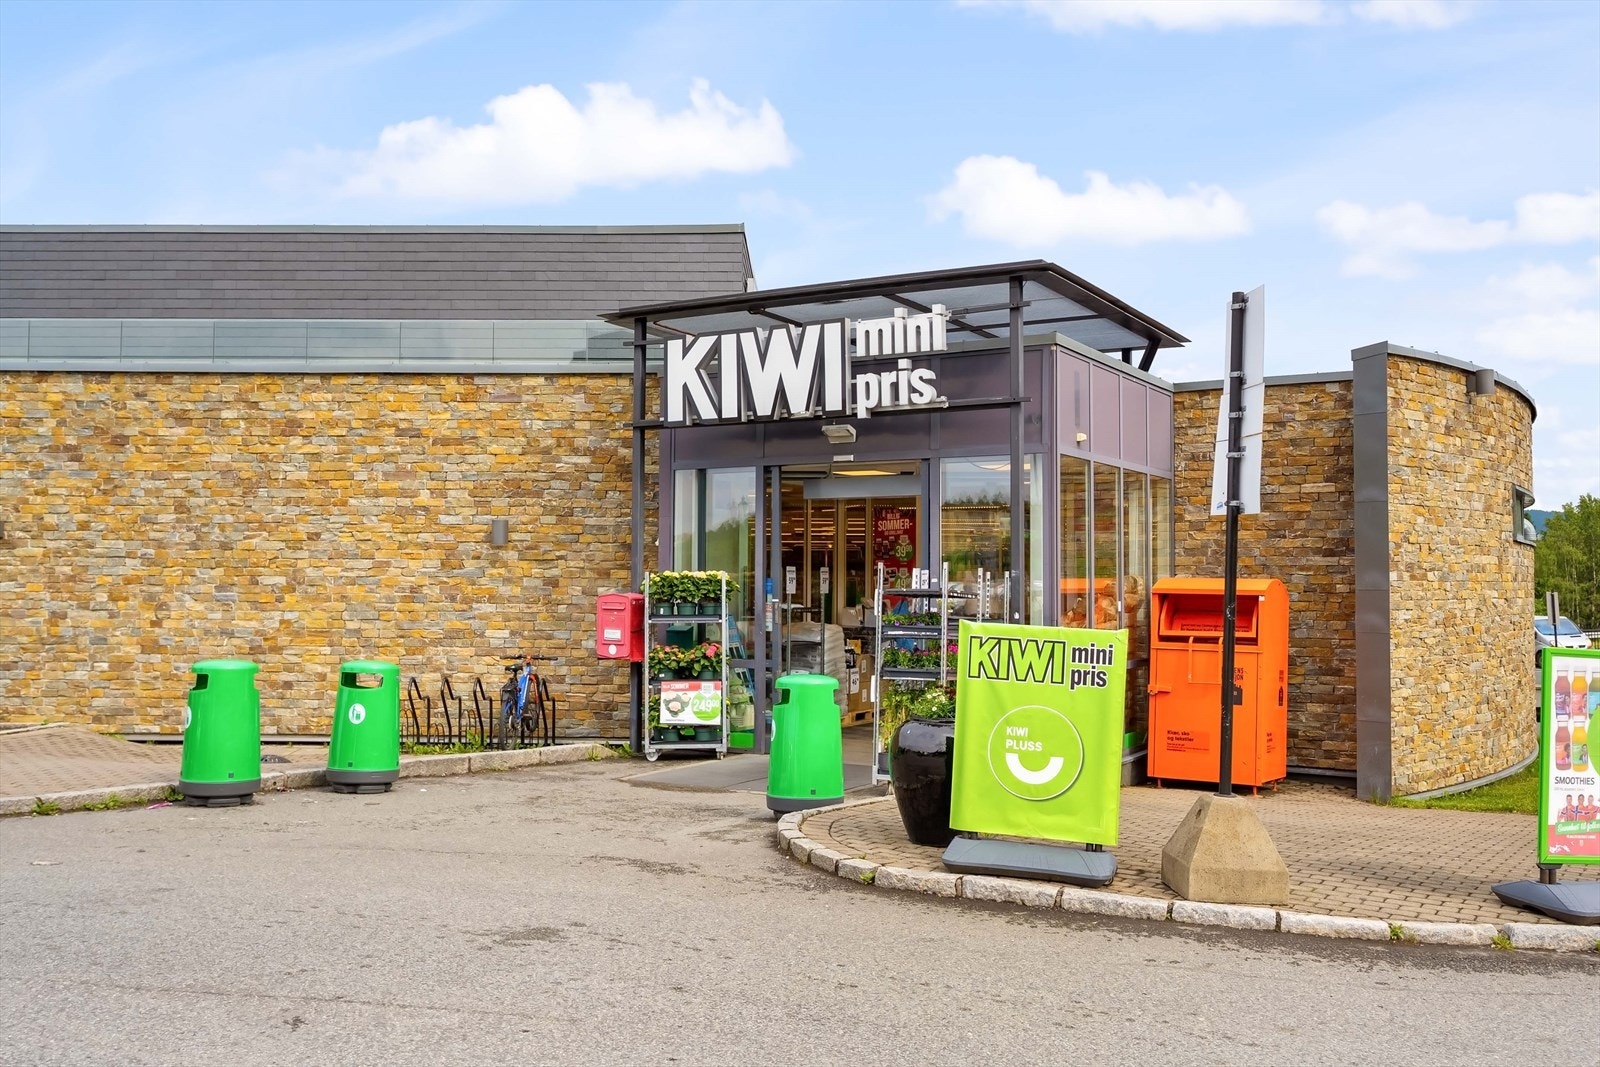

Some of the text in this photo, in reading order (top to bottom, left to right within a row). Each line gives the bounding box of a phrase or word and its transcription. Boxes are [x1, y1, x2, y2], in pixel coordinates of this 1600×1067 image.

[857, 304, 947, 356] mini
[664, 318, 850, 426] KIWI
[968, 635, 1114, 684] KIWI mini
[1070, 665, 1107, 690] pris
[1006, 726, 1029, 737] KIWI
[1005, 738, 1043, 752] PLUSS
[1554, 776, 1595, 786] SMOOTHIES
